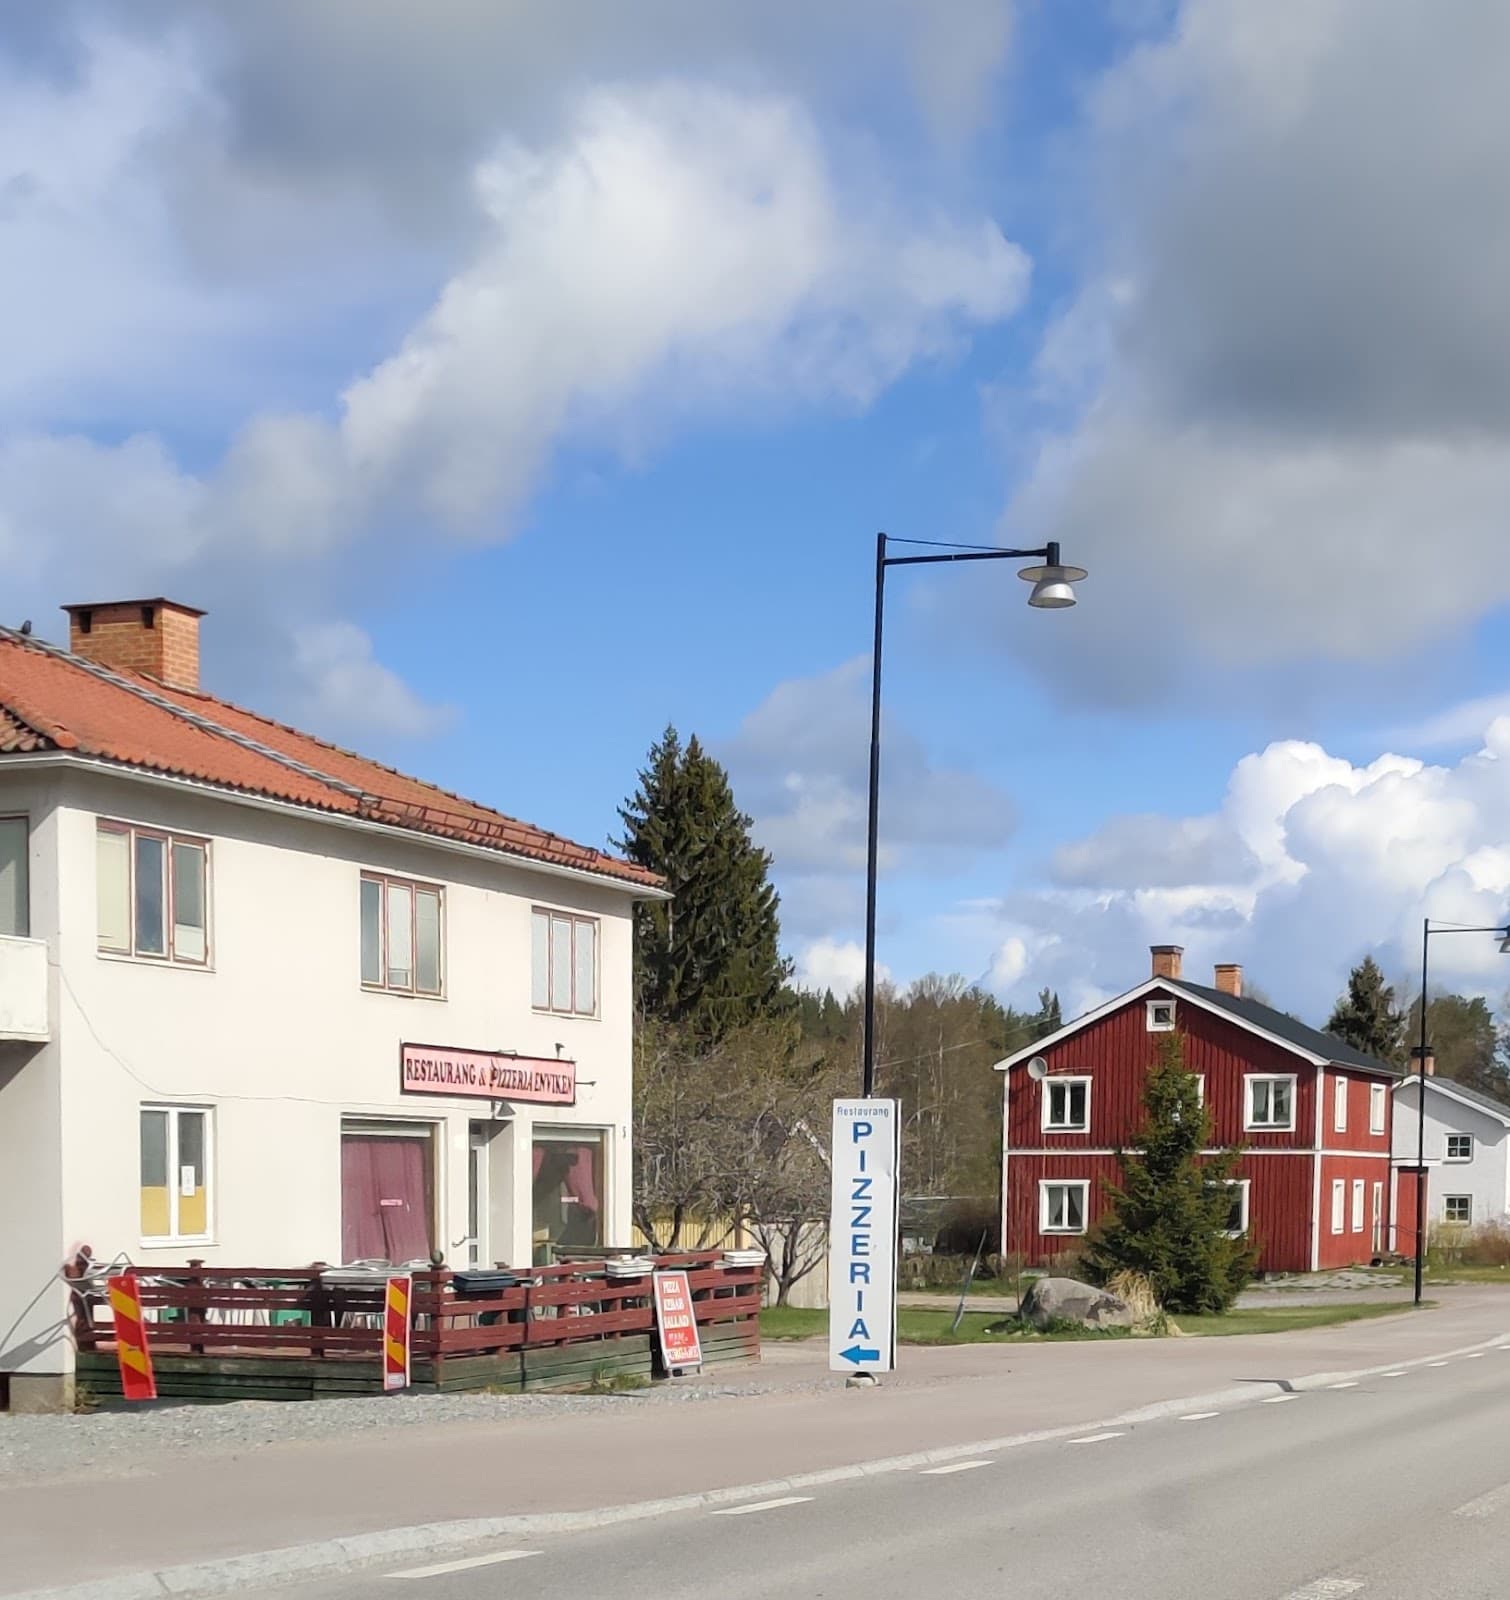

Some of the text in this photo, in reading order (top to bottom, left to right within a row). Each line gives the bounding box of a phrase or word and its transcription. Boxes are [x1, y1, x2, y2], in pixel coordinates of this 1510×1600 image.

[406, 1058, 572, 1095] RESTAURANG & PIZZERIA ENVIKEN
[837, 1106, 889, 1118] Restaurang
[848, 1122, 873, 1340] PIZZERIA
